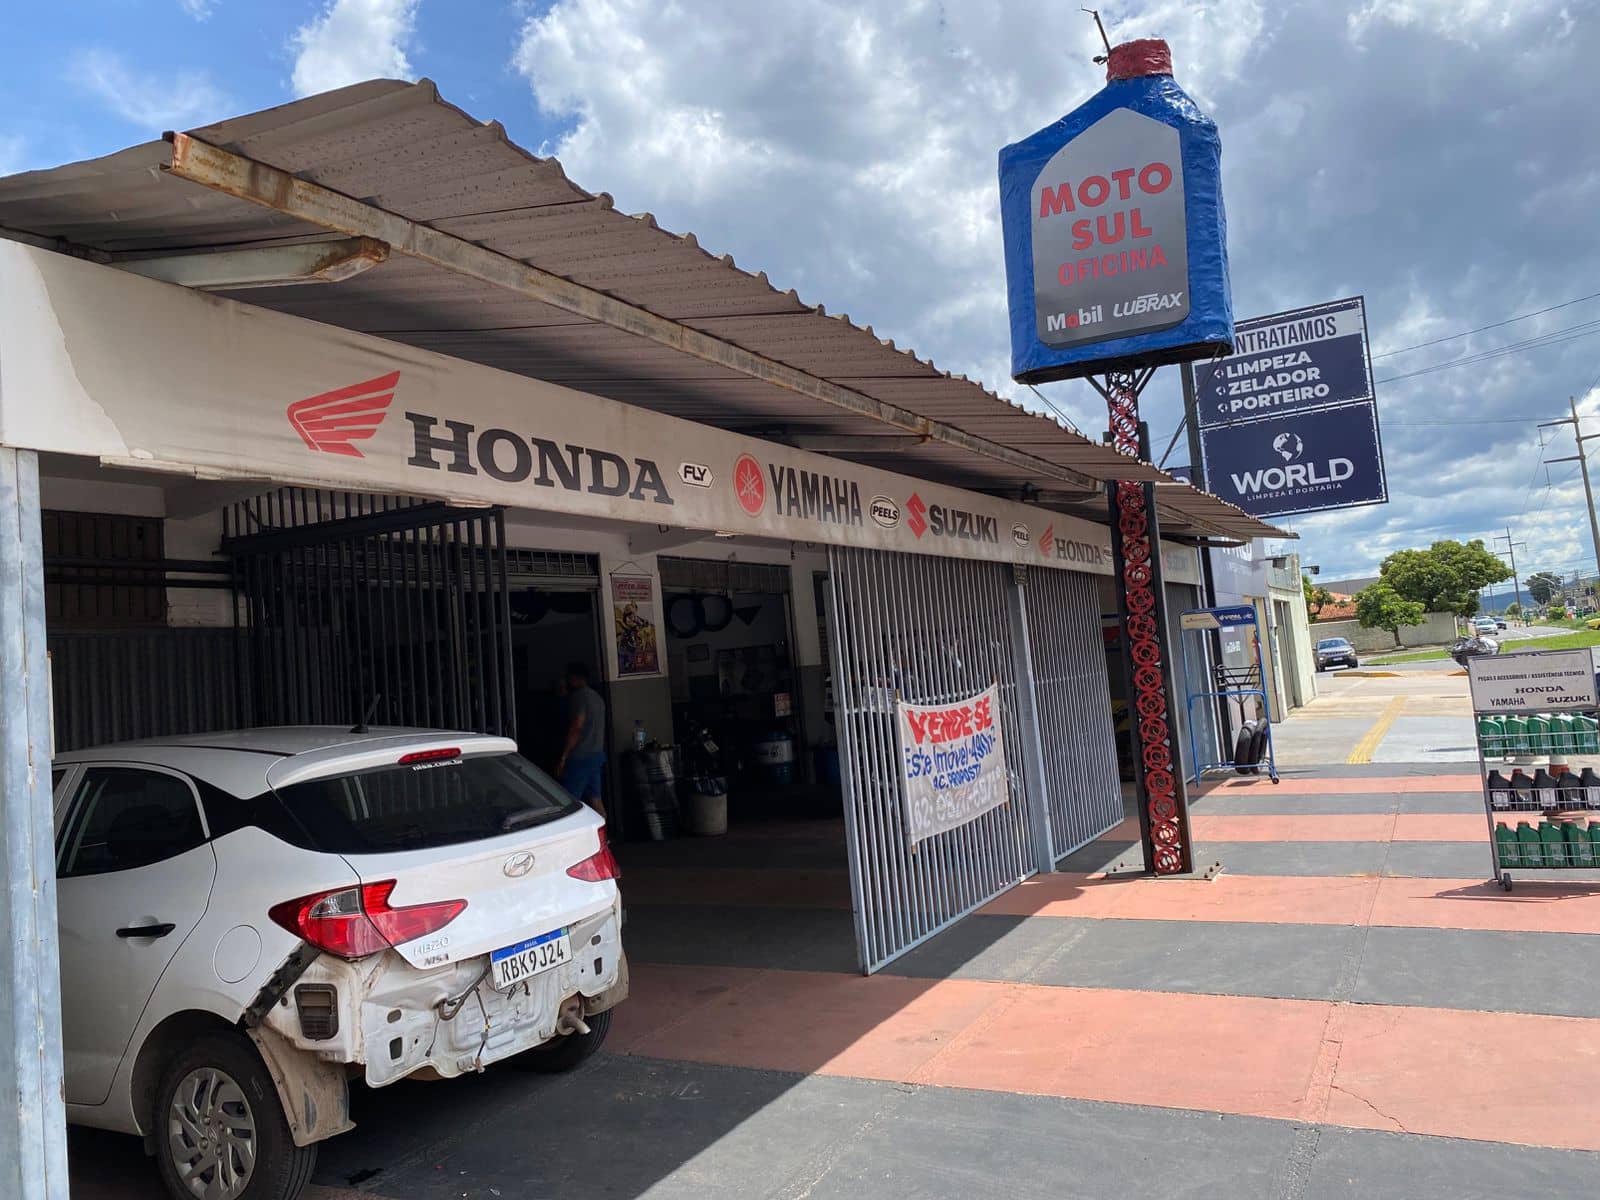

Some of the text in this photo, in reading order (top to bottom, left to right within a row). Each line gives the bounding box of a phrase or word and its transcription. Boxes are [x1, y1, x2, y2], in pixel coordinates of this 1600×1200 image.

[1040, 162, 1172, 218] MOTO
[1072, 208, 1152, 251] SUL
[1058, 244, 1168, 286] OFICINA
[1047, 292, 1183, 331] Mobil LUBRAX
[1235, 316, 1337, 354] NTRATAMOS
[1226, 351, 1312, 378] LIMPEZA
[1228, 367, 1320, 396] ZELADOR
[1230, 383, 1330, 412] PORTEIRO
[405, 411, 674, 505] HONDA
[683, 465, 707, 482] FLY
[1230, 457, 1354, 495] WORLD
[1247, 490, 1286, 501] LIMPEZA
[1295, 482, 1343, 495] PORTARIA
[768, 463, 864, 527] YAMAHA
[872, 504, 898, 521] PEELS
[929, 504, 999, 544] SUZUKI
[1055, 538, 1104, 565] HONDA
[1490, 698, 1526, 706] YAMAHA
[1515, 686, 1565, 694] HONDA
[905, 747, 931, 778] Este
[501, 939, 564, 983] RBK9J24
